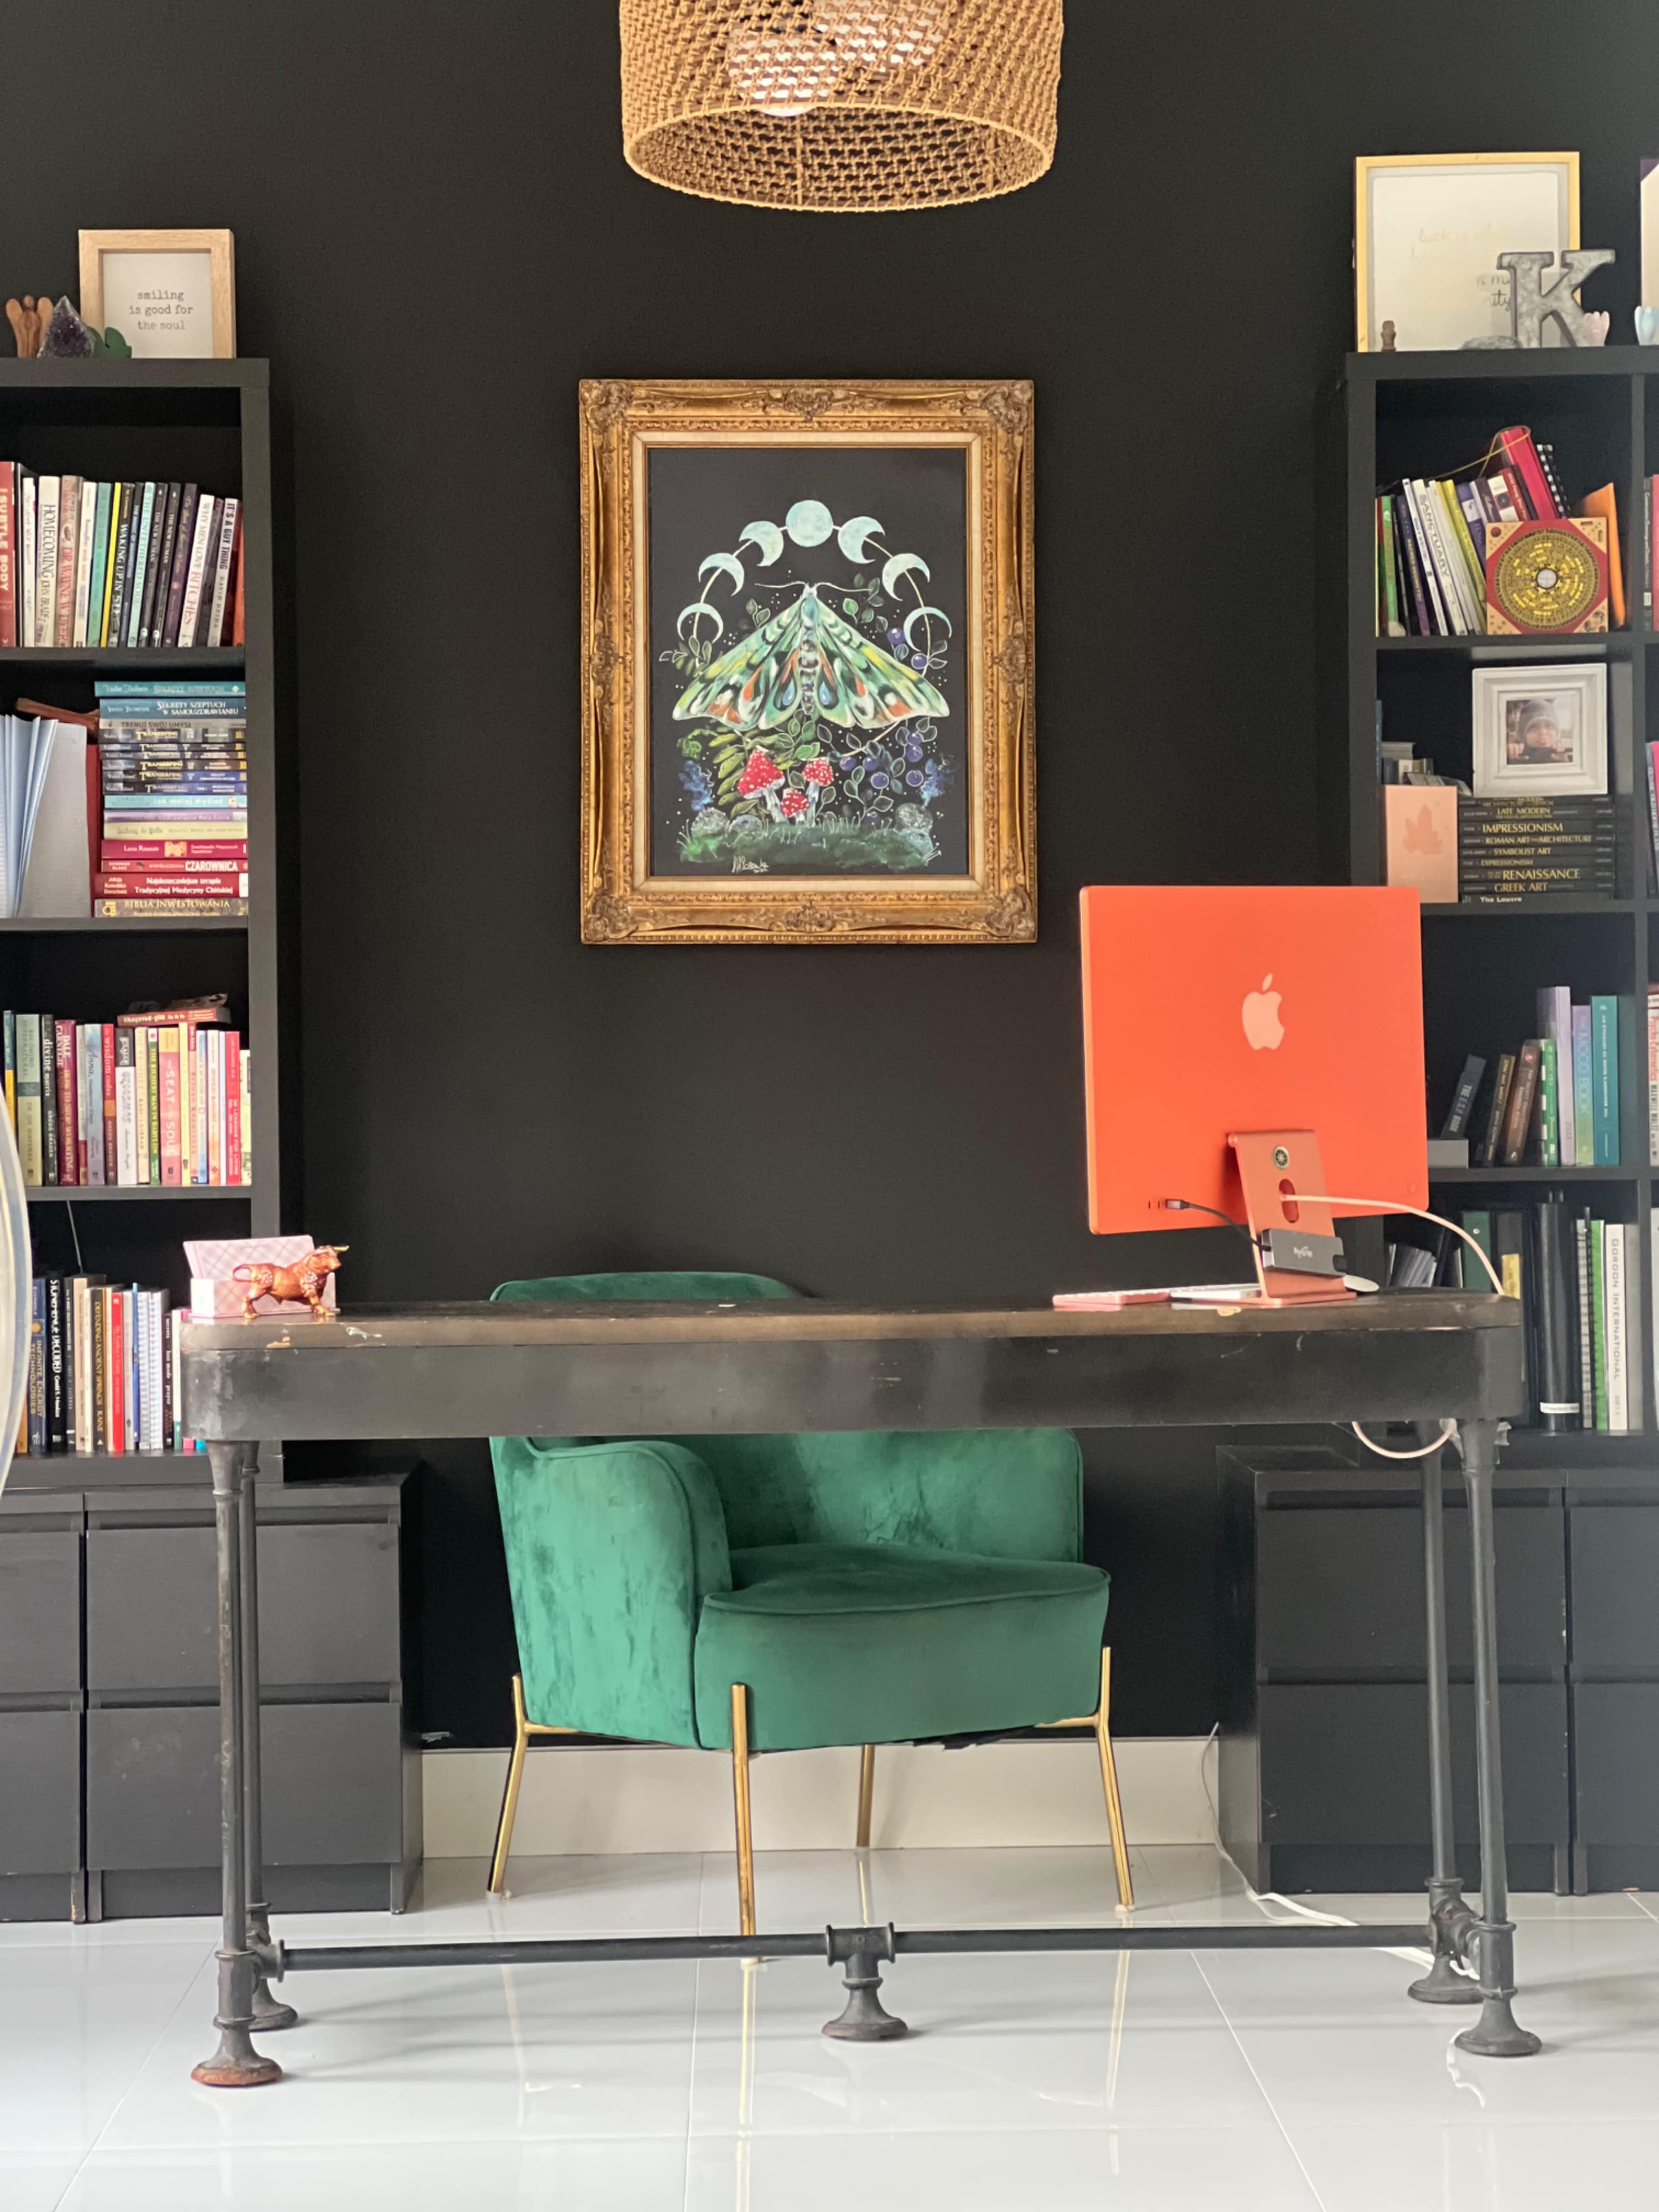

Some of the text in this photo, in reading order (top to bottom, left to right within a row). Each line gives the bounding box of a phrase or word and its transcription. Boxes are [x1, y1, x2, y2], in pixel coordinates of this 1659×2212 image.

[137, 290, 184, 302] smiling
[129, 305, 194, 316] is good for
[137, 321, 185, 330] the soul
[143, 497, 152, 513] THE
[226, 503, 236, 518] IT'S
[41, 504, 56, 579] HOMECOMING
[136, 516, 150, 580] UNTETHERED
[222, 528, 232, 543] GUY
[1421, 494, 1449, 577] SANCTUARY
[114, 524, 129, 591] WAKING UP IN
[184, 502, 210, 625] WHY MEN LOVE BITCHES
[219, 547, 229, 570] THING
[0, 553, 9, 591] BODY
[60, 564, 72, 599] WAYNE
[1483, 823, 1563, 833] IMPRESSIONISM
[185, 861, 238, 872] CZAROWNICA
[1503, 868, 1580, 880] RENAISSANCE
[172, 887, 204, 895] Medycyny
[1494, 882, 1549, 893] GREEK ART
[124, 899, 230, 908] BIBLIA INWESTOWANIA
[44, 1039, 53, 1071] divine
[88, 1050, 99, 1078] Anna,
[105, 1036, 114, 1074] wisdom
[1578, 1032, 1590, 1115] MOOD BOOK
[165, 1070, 176, 1157] SEAT SOUL
[1611, 1239, 1620, 1288] GORDON
[1612, 1293, 1621, 1381] INTERNATIONAL
